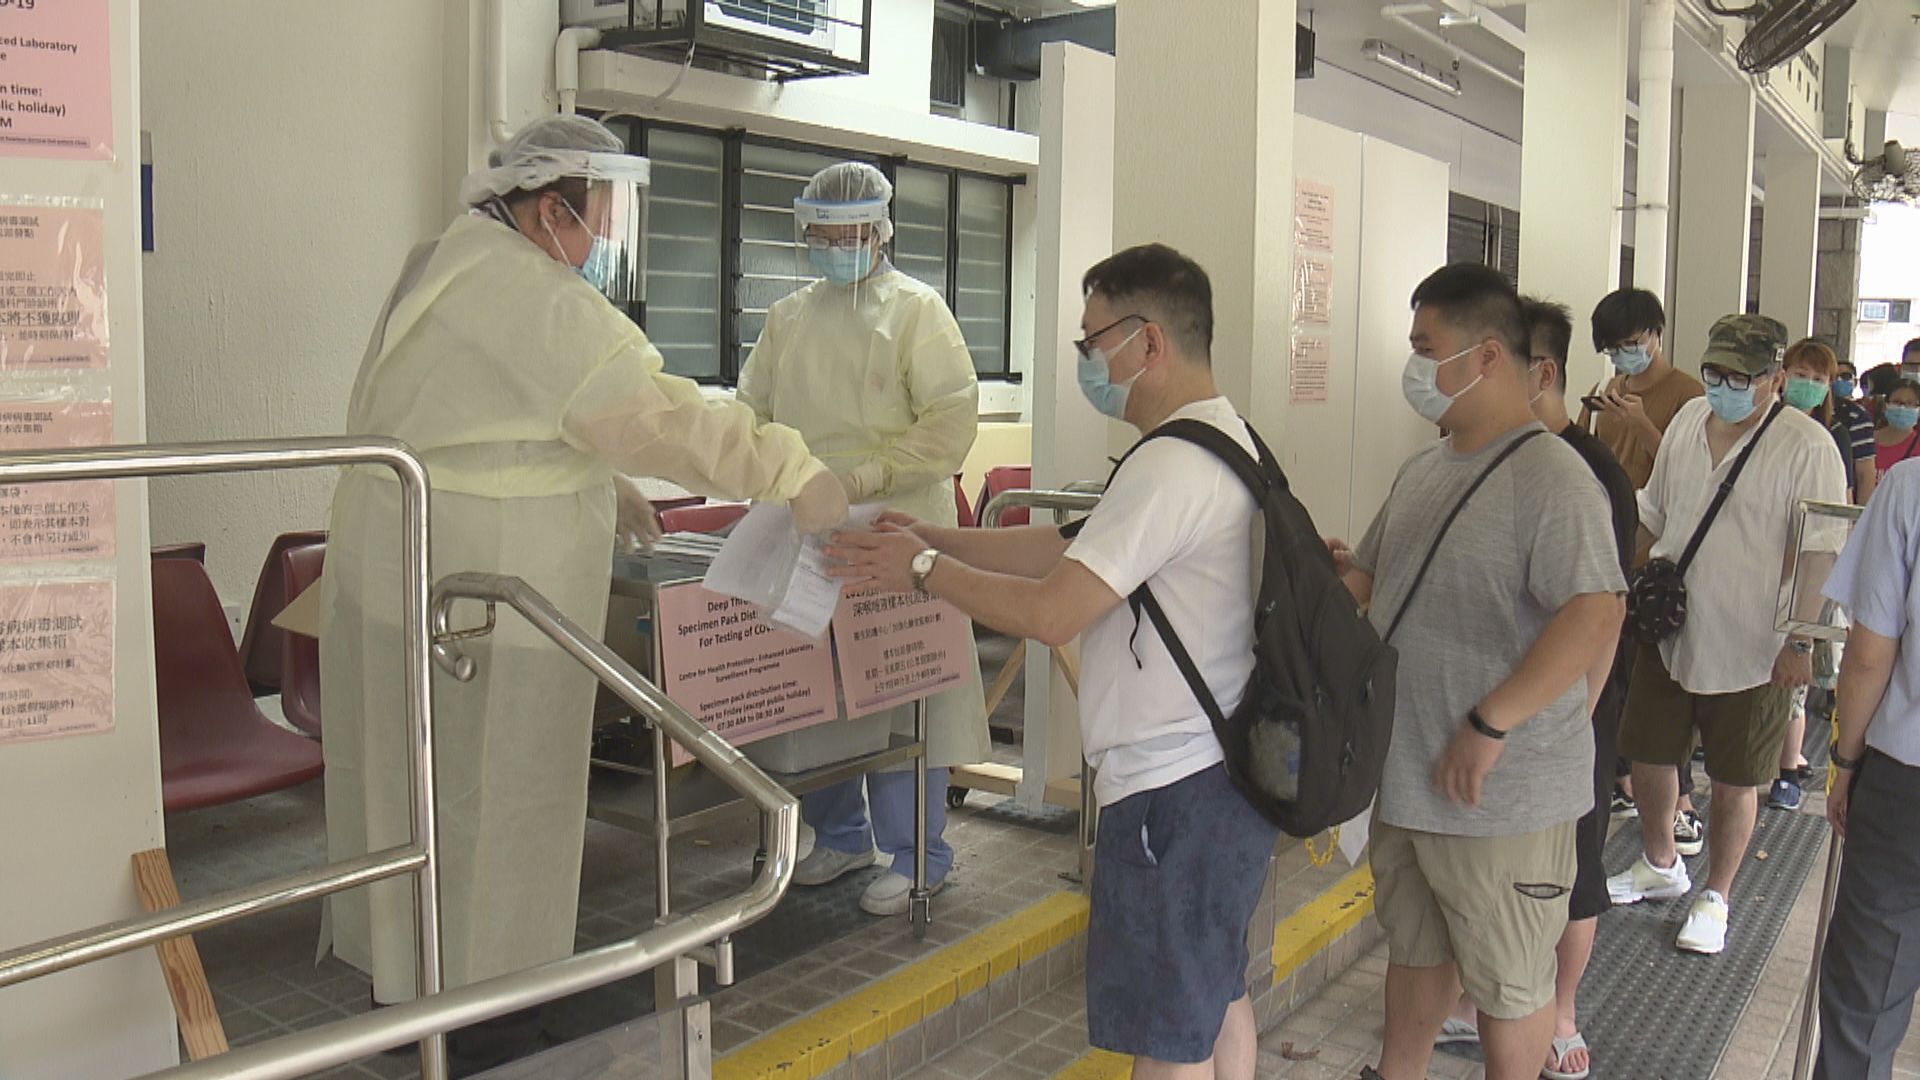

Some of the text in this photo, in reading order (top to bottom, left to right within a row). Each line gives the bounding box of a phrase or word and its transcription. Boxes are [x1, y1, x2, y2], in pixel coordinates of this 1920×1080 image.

[20, 37, 77, 54] Laboratory
[10, 84, 42, 96] time:
[18, 100, 66, 117] holiday)
[707, 600, 729, 613] Deep
[678, 620, 719, 636] Specimen
[720, 613, 739, 626] Pack
[699, 638, 713, 648] For
[715, 630, 742, 645] Testing
[744, 626, 753, 637] of
[679, 672, 697, 681] Centre
[698, 666, 706, 675] for
[707, 664, 725, 673] Health
[727, 657, 755, 669] Protection
[758, 650, 784, 661] Enhanced
[786, 644, 814, 655] Laboratory
[716, 662, 780, 683] Surveillance Programme
[700, 680, 798, 711] Specimen pack distribution time:
[723, 707, 742, 717] Friday
[744, 699, 765, 712] (except
[766, 696, 784, 707] public
[786, 687, 811, 699] holiday)
[735, 716, 747, 726] AM
[774, 706, 785, 715] AM
